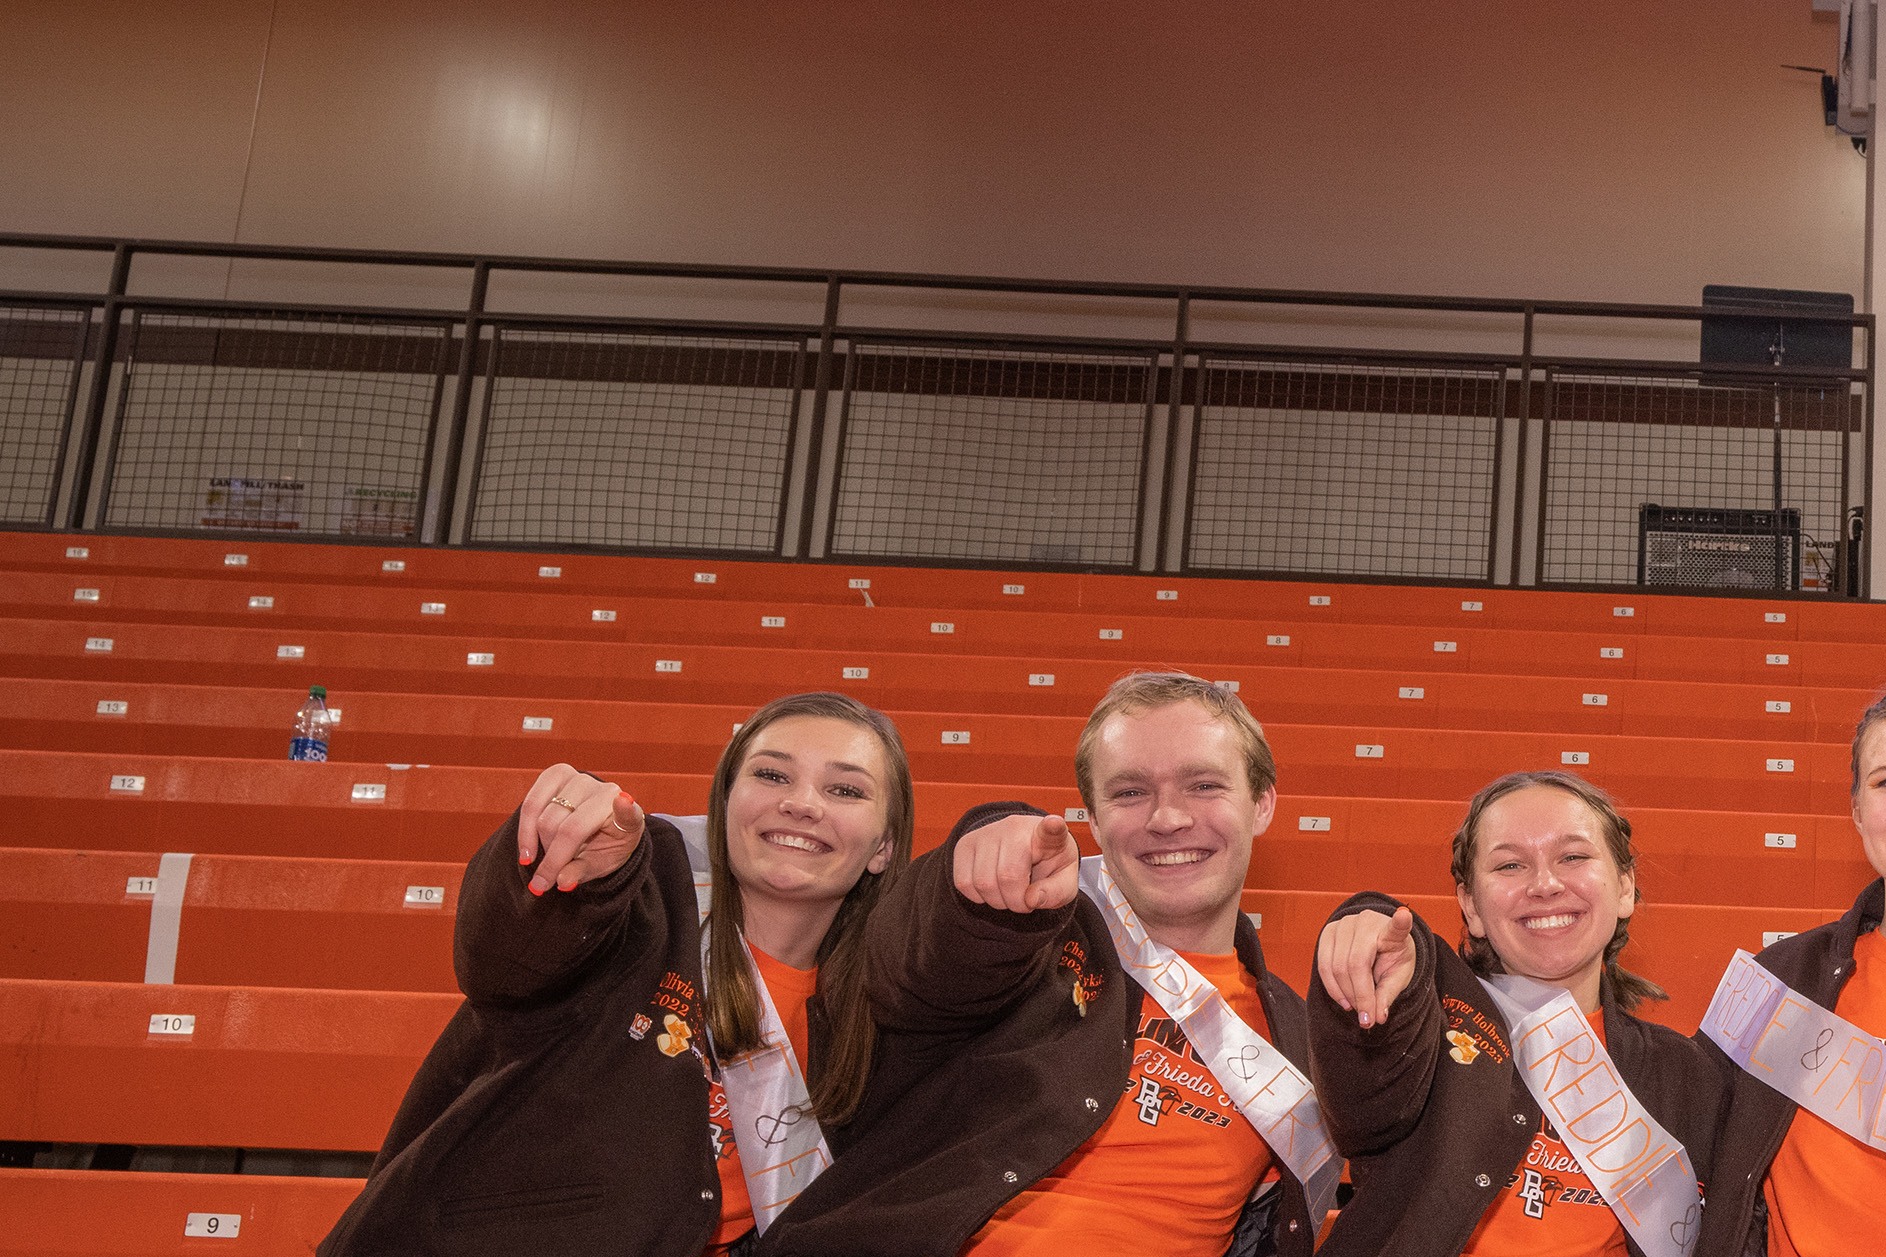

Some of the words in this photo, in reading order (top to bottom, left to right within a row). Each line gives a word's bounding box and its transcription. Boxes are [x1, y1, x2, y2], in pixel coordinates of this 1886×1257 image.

[1009, 586, 1019, 594] 10
[1164, 591, 1171, 599] 9
[1317, 596, 1323, 605] 8
[1470, 602, 1475, 610] 7
[1620, 608, 1627, 616] 6
[768, 618, 778, 626] 11
[1772, 614, 1778, 622] 5
[938, 624, 948, 632] 10
[1108, 630, 1114, 639] 9
[1275, 636, 1282, 645] 8
[1443, 642, 1449, 651] 7
[1608, 649, 1615, 657] 6
[1774, 655, 1781, 664] 5
[663, 662, 674, 670] 11
[850, 668, 863, 678] 10
[1038, 675, 1046, 685] 9
[1408, 688, 1415, 697] 7
[1591, 695, 1598, 704] 6
[106, 702, 119, 713] 13
[1775, 702, 1782, 712] 5
[952, 732, 960, 743] 9
[1366, 746, 1373, 756] 7
[1571, 753, 1579, 763] 6
[1776, 761, 1784, 770] 5
[120, 778, 135, 788] 12
[1076, 808, 1084, 820] 8
[1311, 819, 1319, 829] 7
[1777, 835, 1785, 846] 5
[138, 880, 154, 890] 11
[417, 888, 434, 901] 10
[162, 1017, 182, 1031] 10
[1800, 1028, 1834, 1072] &
[1226, 1045, 1260, 1083] &
[1143, 1050, 1215, 1098] Frieda
[1175, 1100, 1232, 1129] 2023
[1518, 1005, 1689, 1227] FREDDIE
[1669, 1203, 1697, 1253] &
[1526, 1139, 1587, 1174] Frie
[1557, 1186, 1611, 1207] 202
[207, 1217, 219, 1234] 9
